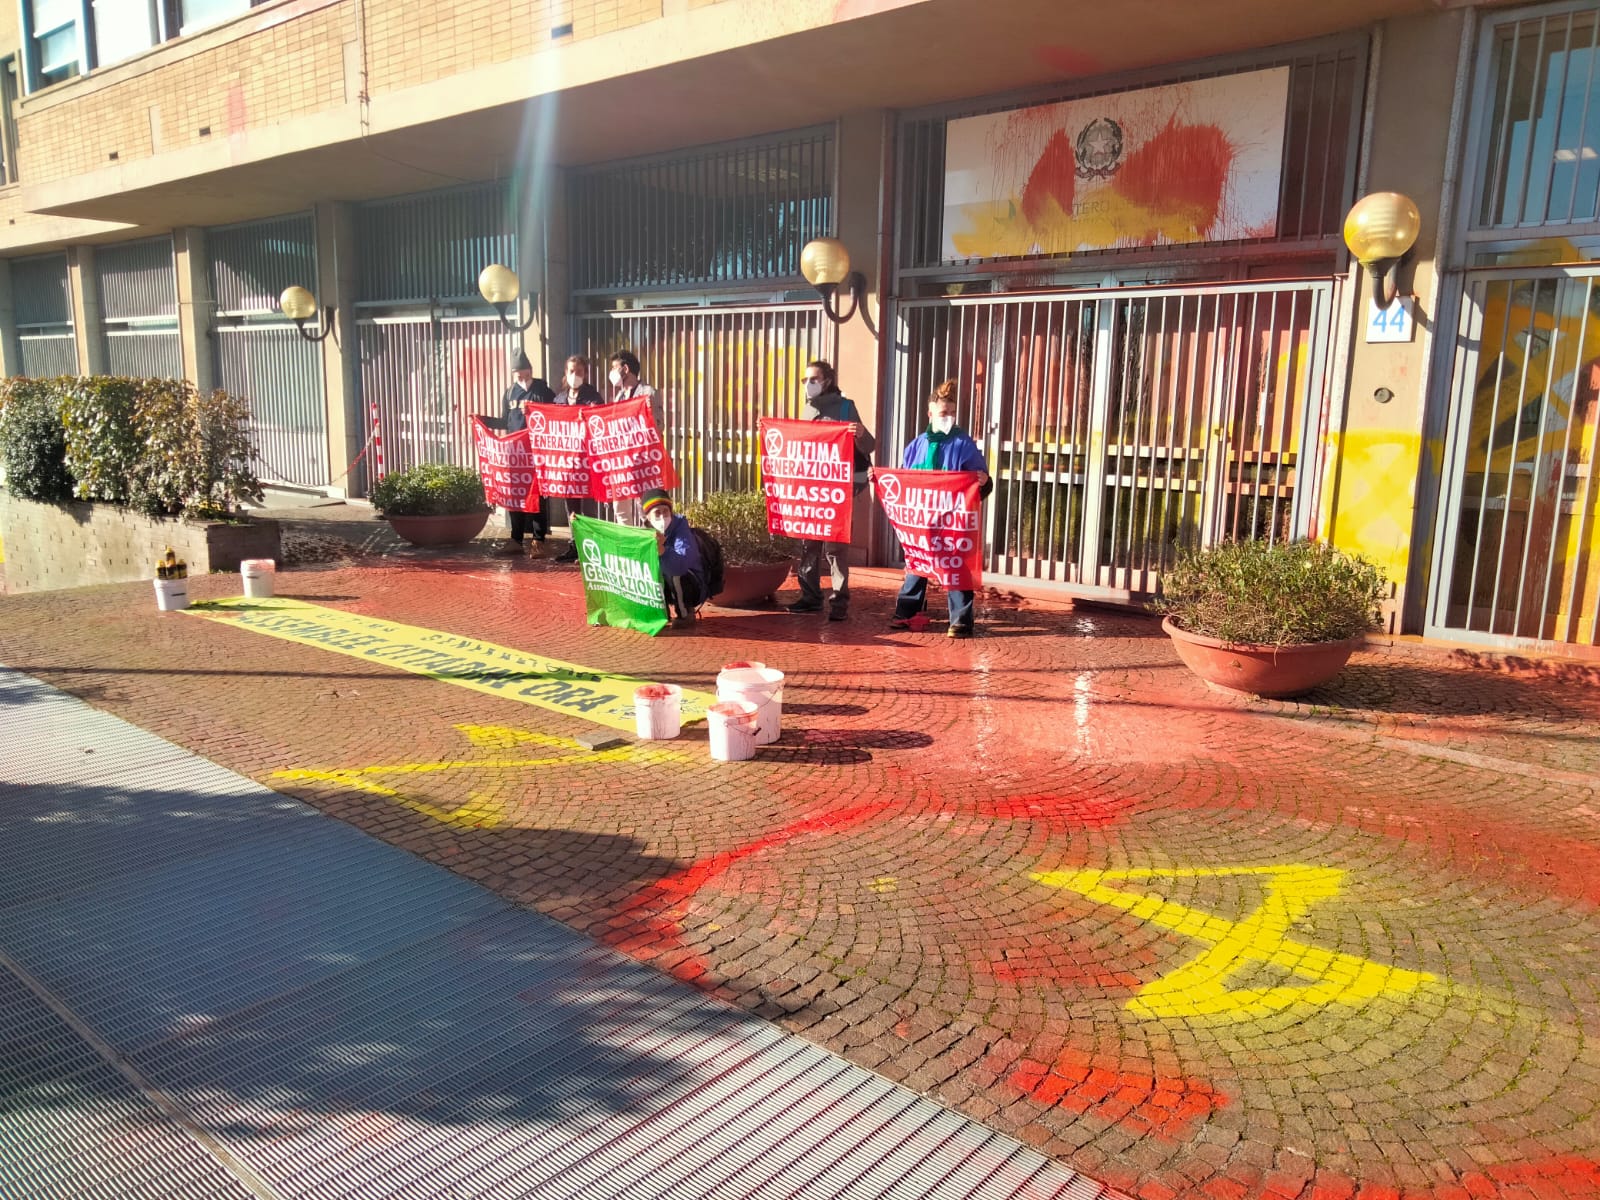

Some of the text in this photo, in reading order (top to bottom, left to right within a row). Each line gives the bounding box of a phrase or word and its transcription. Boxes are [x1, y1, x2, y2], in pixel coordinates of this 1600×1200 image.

[1372, 307, 1406, 333] 44
[548, 420, 586, 440] ULTIMA
[607, 414, 648, 437] ULTIMA
[589, 428, 659, 456] GENERAZIONE
[786, 440, 841, 464] ULTIMA
[592, 449, 663, 474] COLLASSO
[762, 456, 850, 482] GENERAZIONE
[602, 465, 661, 486] CLIMATICO
[606, 478, 664, 499] E SOCIALE
[764, 482, 846, 504] COLLASSO
[905, 487, 967, 512] ULTIMA
[893, 526, 973, 552] OLLASSO
[604, 553, 654, 582] ULTIMA
[584, 563, 664, 600] GENERAZIONE
[518, 681, 620, 713] ORA
